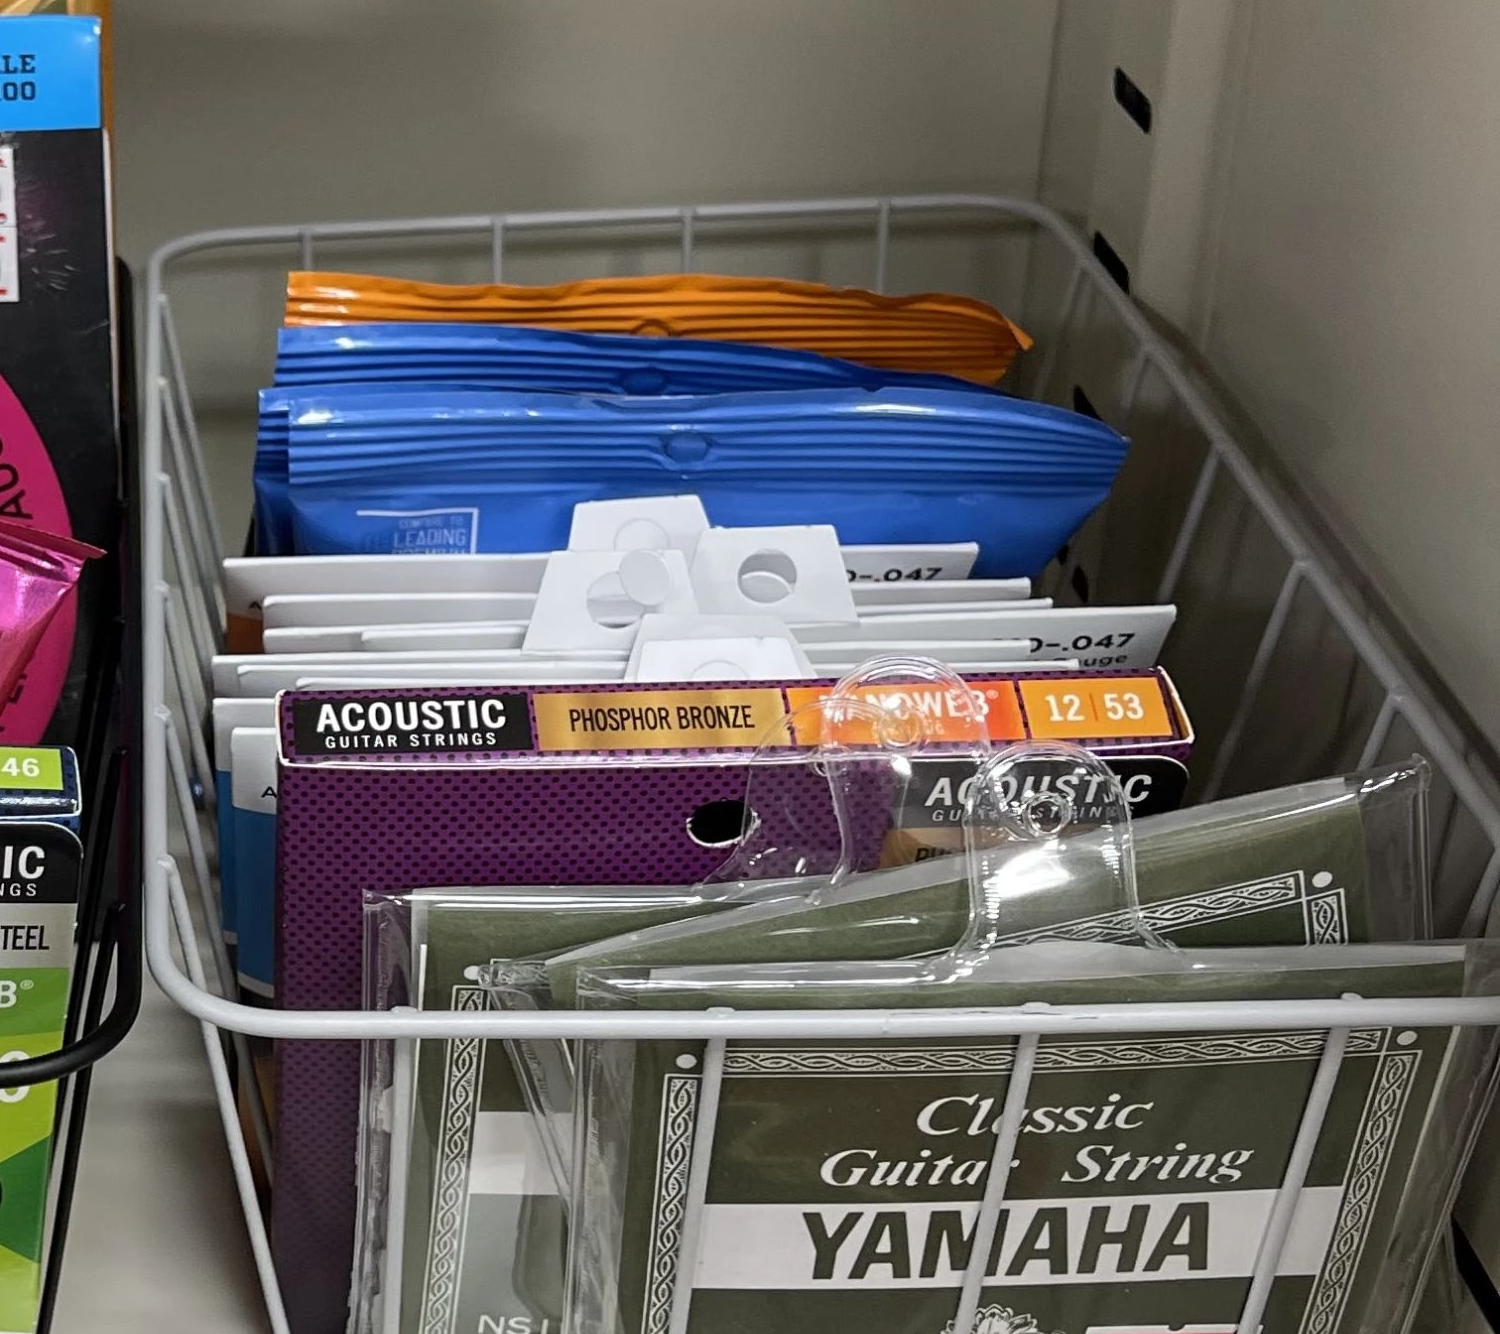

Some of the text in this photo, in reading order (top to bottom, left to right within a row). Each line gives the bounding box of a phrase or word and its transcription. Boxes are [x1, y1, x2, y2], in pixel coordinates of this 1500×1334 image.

[393, 528, 467, 548] LEADING
[315, 698, 507, 734] ACOUSTIC
[569, 706, 673, 733] PHOSPHOR
[676, 704, 756, 731] BRONZE
[1044, 693, 1086, 724] 12
[1103, 691, 1145, 721] 53
[325, 731, 497, 749] GUITAR STRINGS
[0, 757, 40, 778] 46
[1060, 1142, 1255, 1185] String
[801, 1200, 1210, 1281] YAMAHA
